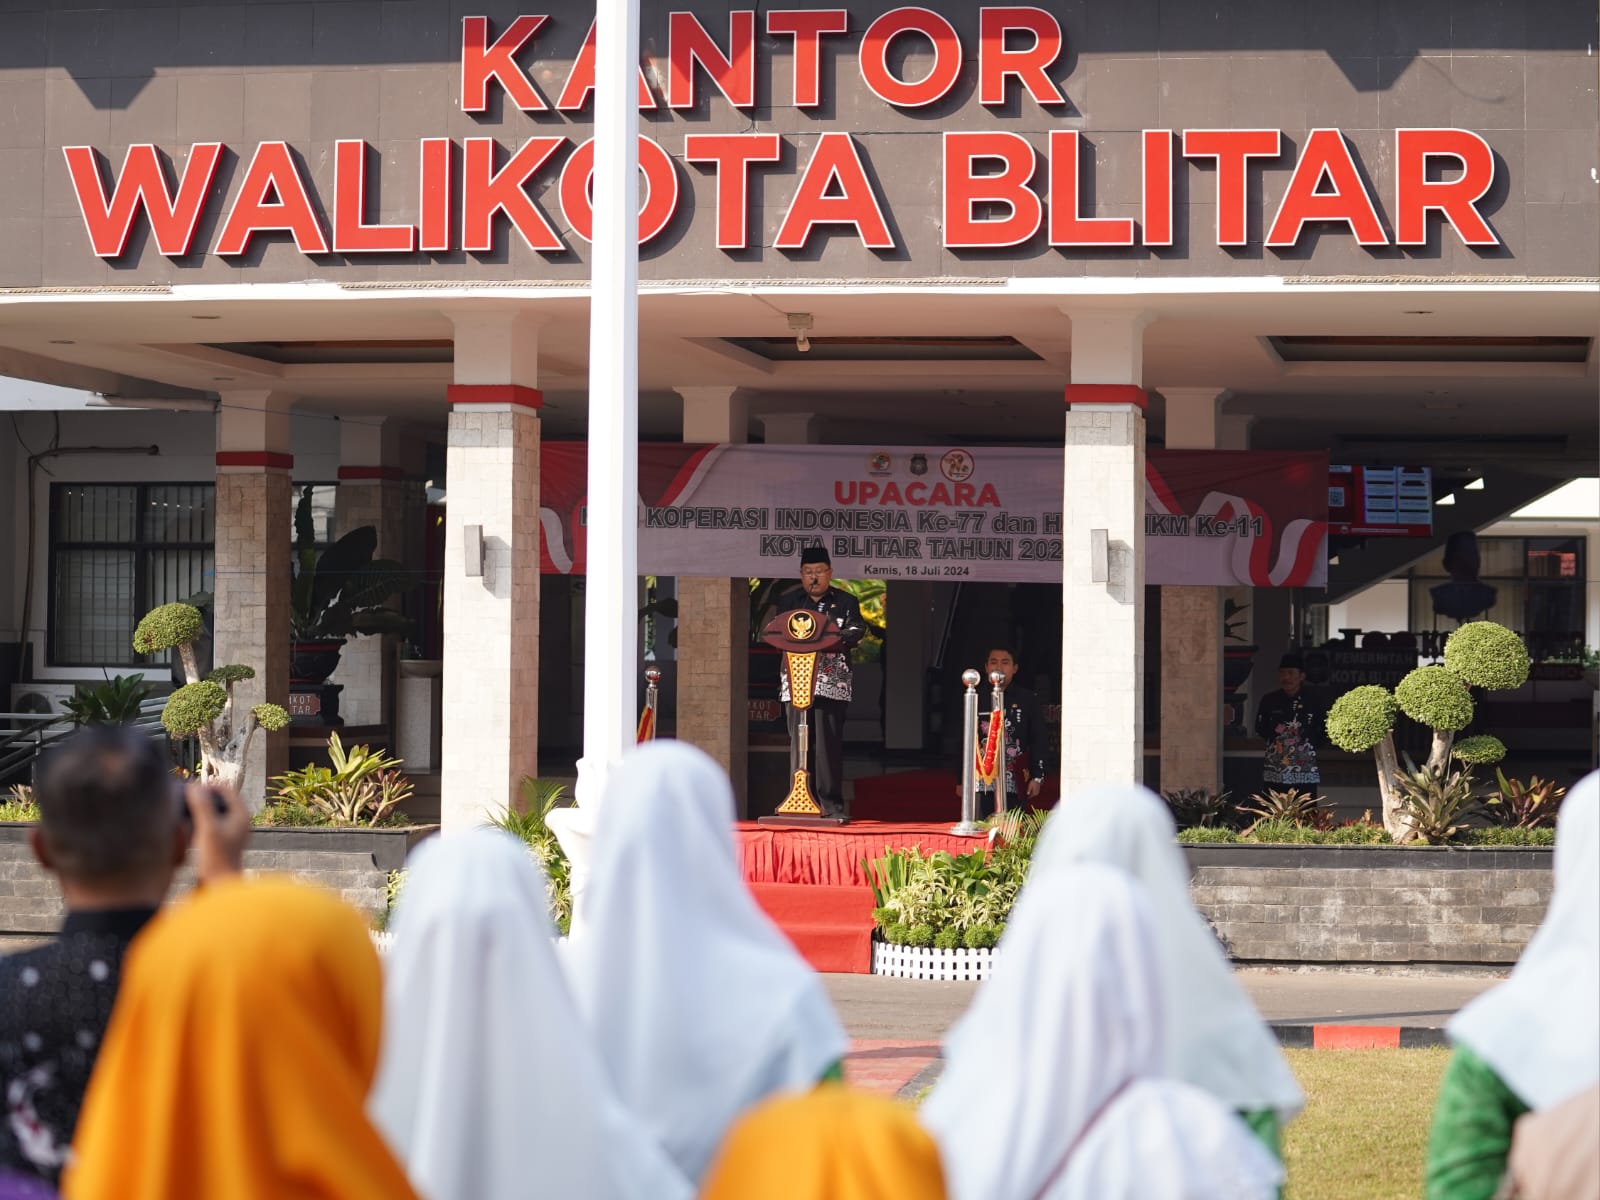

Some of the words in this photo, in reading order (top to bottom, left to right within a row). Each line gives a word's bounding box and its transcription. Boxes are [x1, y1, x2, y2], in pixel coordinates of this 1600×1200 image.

[63, 132, 895, 258] WALIKOTA
[943, 127, 1500, 247] BLITAR
[835, 481, 1001, 507] UPACARA
[646, 507, 768, 530] KOPERASI
[775, 508, 912, 532] INDONESIA
[917, 510, 987, 533] Ke-77
[991, 512, 1038, 534] dan
[1195, 514, 1263, 538] Ke-11
[760, 535, 825, 557] KOTA
[832, 535, 922, 559] BLITAR
[926, 537, 1014, 559] TAHUN
[1018, 538, 1063, 561] 202
[864, 565, 902, 576] Kamis,
[905, 565, 917, 575] 18
[920, 566, 941, 576] Juli
[944, 566, 970, 576] 2024
